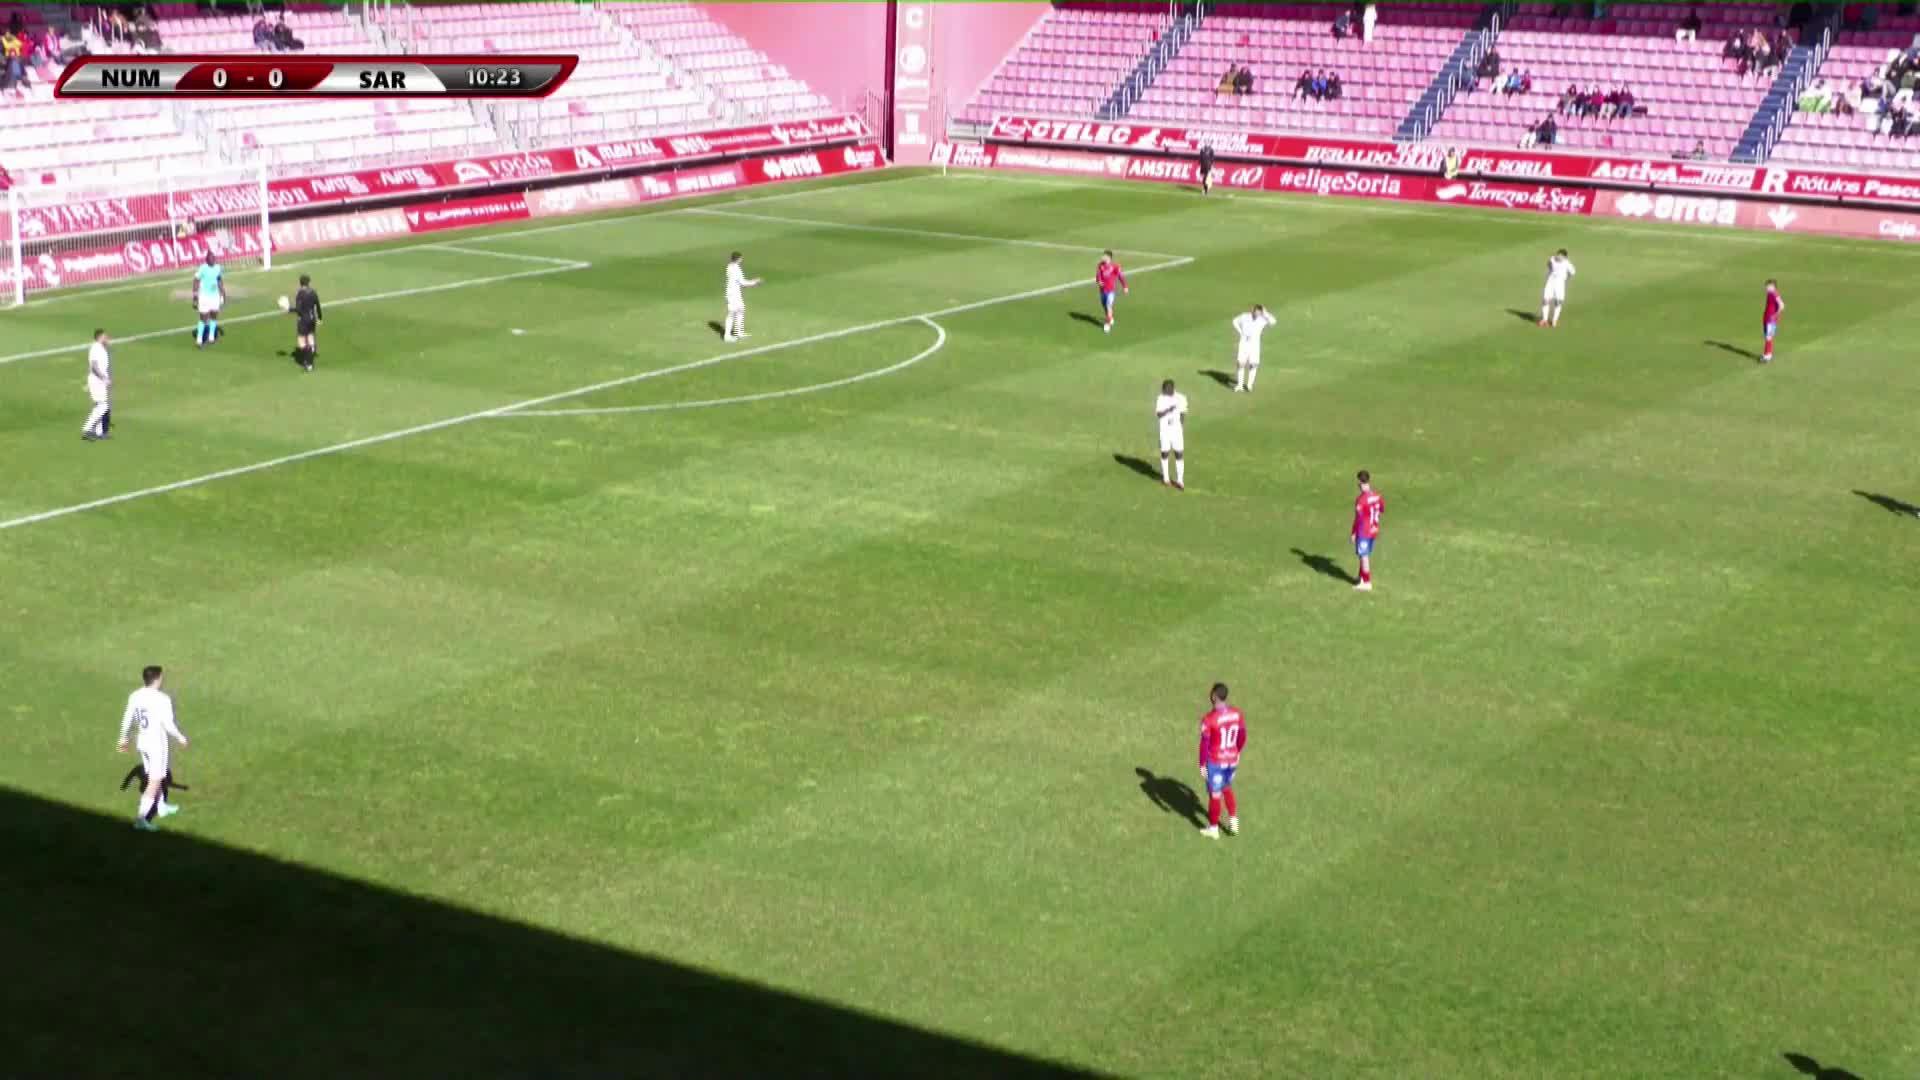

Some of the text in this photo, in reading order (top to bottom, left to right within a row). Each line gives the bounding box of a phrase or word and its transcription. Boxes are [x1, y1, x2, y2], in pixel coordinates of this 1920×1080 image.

[1129, 159, 1192, 180] AMSTEL
[1466, 155, 1494, 173] DE
[1496, 158, 1553, 177] SORIA
[1593, 160, 1679, 184] ActivA
[1761, 168, 1789, 194] R
[1792, 174, 1861, 195] Rótulos
[1550, 188, 1586, 212] Soria
[1653, 194, 1737, 224] errea
[1220, 724, 1240, 749] 10
